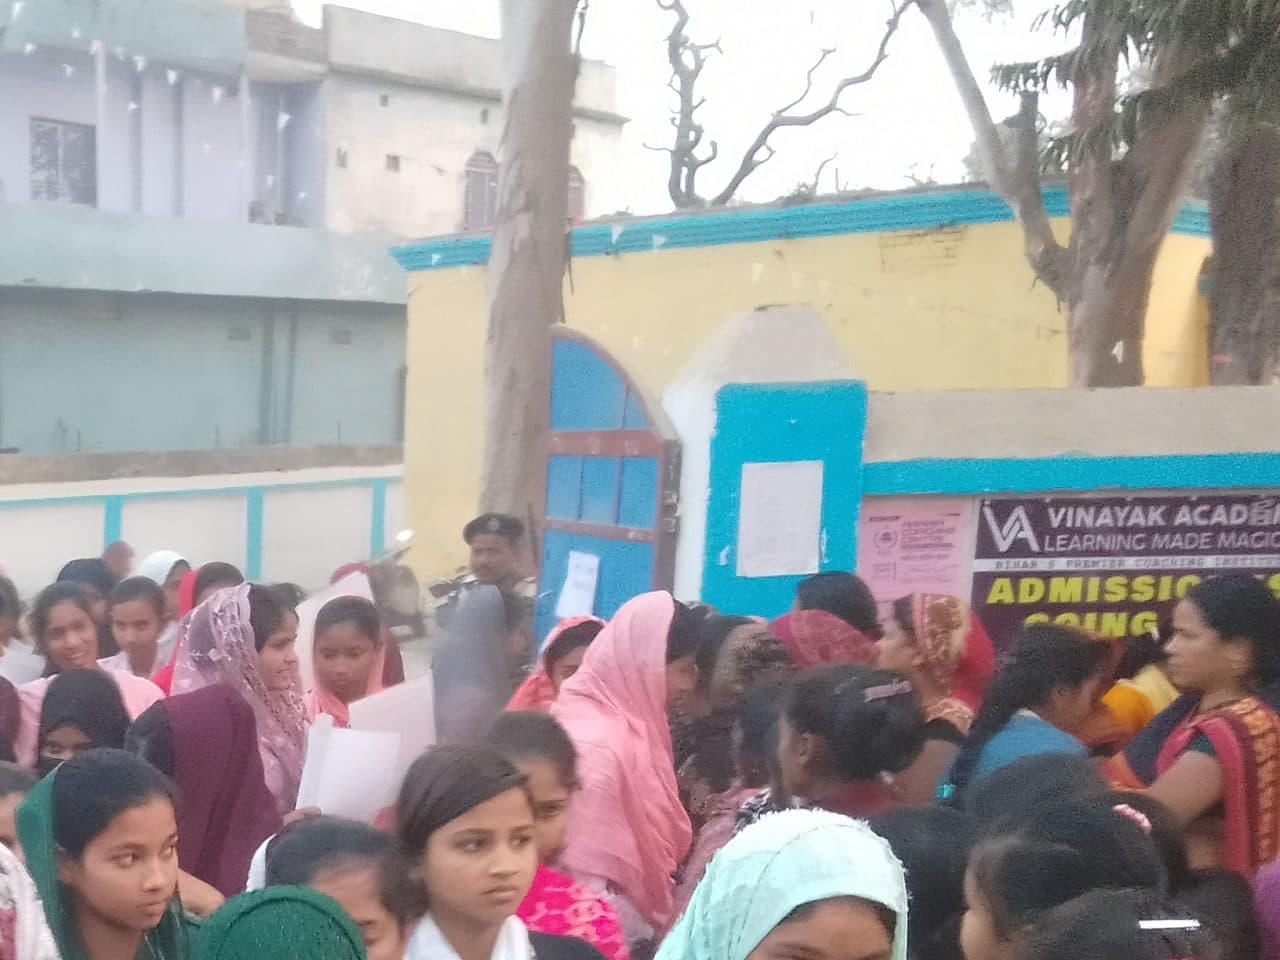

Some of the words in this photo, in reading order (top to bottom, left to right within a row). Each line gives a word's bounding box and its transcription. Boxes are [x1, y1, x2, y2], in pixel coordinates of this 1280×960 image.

[1048, 506, 1168, 528] VINAYAK
[1044, 533, 1147, 551] LEARNING
[1150, 532, 1215, 550] MADE
[986, 573, 1202, 605] ADMISSIO
